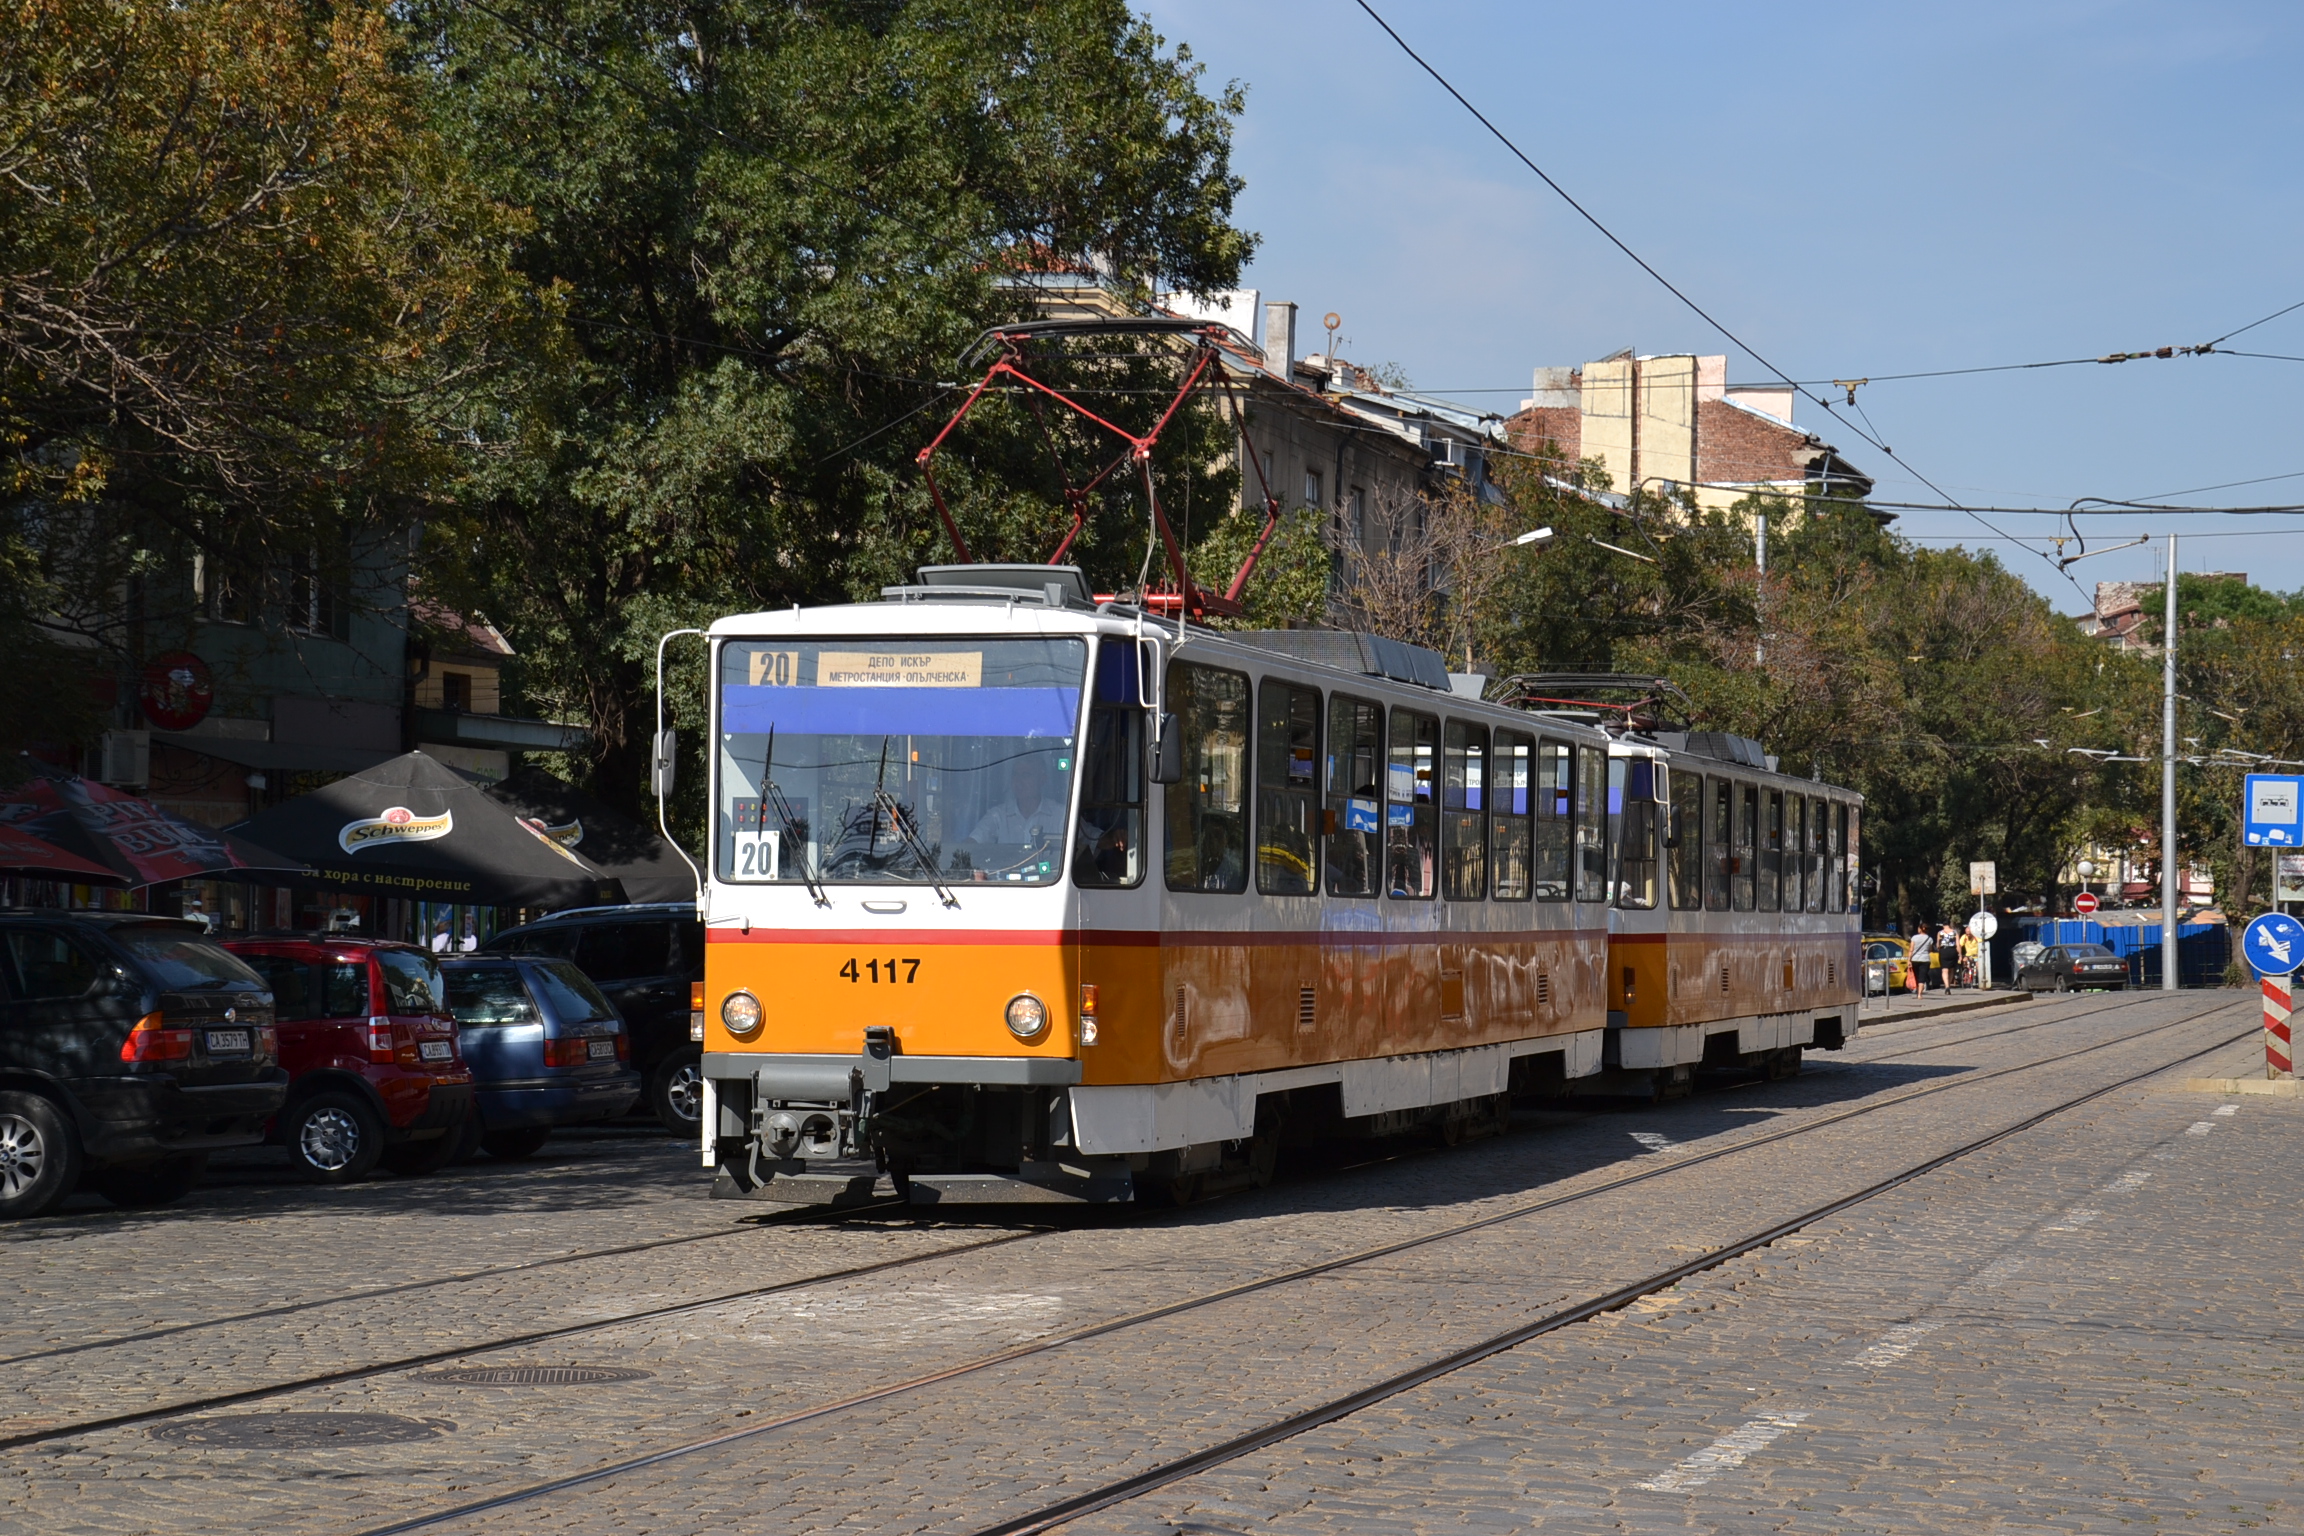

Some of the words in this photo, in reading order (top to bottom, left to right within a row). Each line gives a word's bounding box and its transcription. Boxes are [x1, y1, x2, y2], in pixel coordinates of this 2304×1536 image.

[760, 653, 790, 686] 20
[868, 656, 895, 668] ДЕПО
[900, 656, 931, 667] ИСКЪР
[829, 671, 901, 683] МЕТРОСТАНЦИЯ
[81, 801, 157, 824] PIT
[352, 821, 445, 842] Schweppes
[742, 842, 772, 874] 20
[324, 869, 359, 883] хора
[363, 873, 372, 882] с
[375, 874, 472, 891] настроение
[839, 958, 921, 984] 4117
